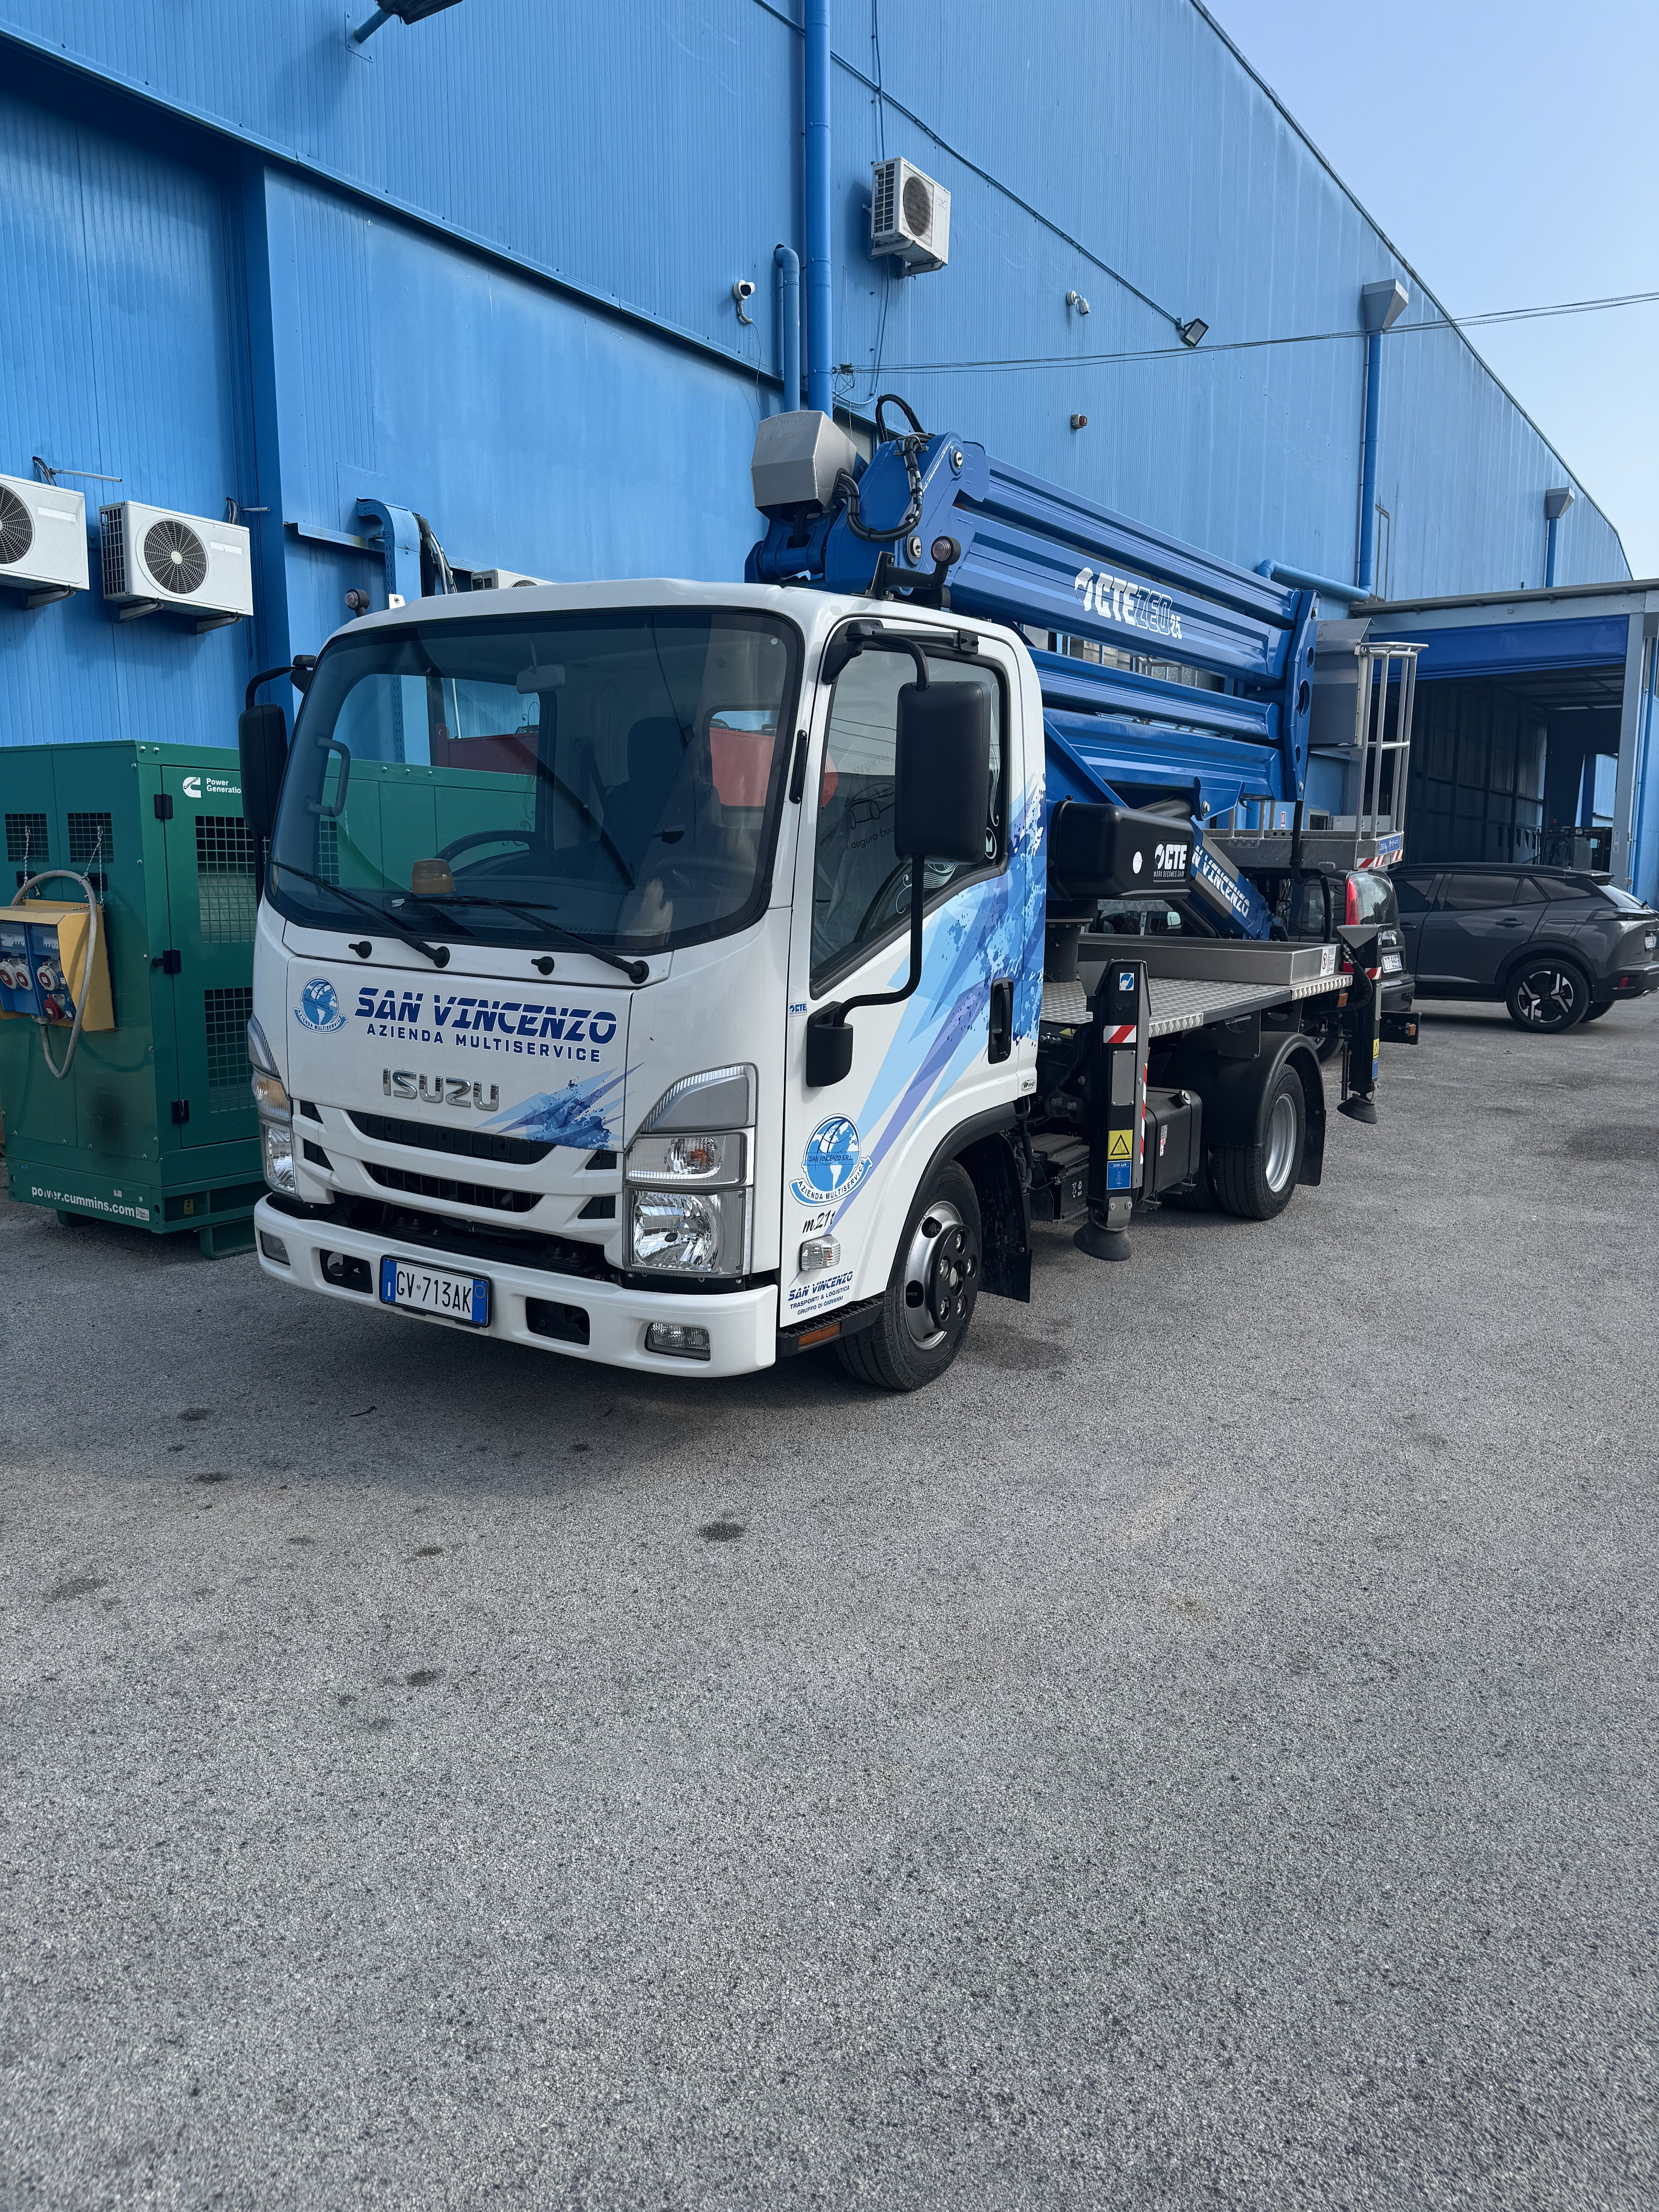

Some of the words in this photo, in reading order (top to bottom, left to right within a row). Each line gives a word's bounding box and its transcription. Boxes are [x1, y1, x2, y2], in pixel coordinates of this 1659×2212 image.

[1170, 614, 1183, 639] 25
[206, 785, 242, 793] Generatio
[851, 834, 878, 848] augura
[1164, 844, 1187, 869] CTE
[1202, 854, 1250, 918] VINCENZO
[298, 1010, 313, 1028] AZIENDA
[314, 1014, 342, 1030] MULTISERVICE
[355, 987, 424, 1024] SAN
[433, 994, 617, 1044] VINCENZO
[366, 1023, 444, 1044] AZIENDA
[456, 1034, 601, 1063] MULTISERVICE
[383, 1068, 500, 1111] ISUZU
[798, 1181, 823, 1200] AZIENDA
[826, 1159, 865, 1199] MULTISERVICE
[788, 1285, 810, 1302] SAN
[812, 1271, 853, 1294] VINCENZO
[790, 1296, 819, 1309] TRASPORTI
[826, 1285, 850, 1298] LOGISTICA
[797, 1305, 817, 1315] GRUPPO
[824, 1295, 843, 1306] GIOVANNI
